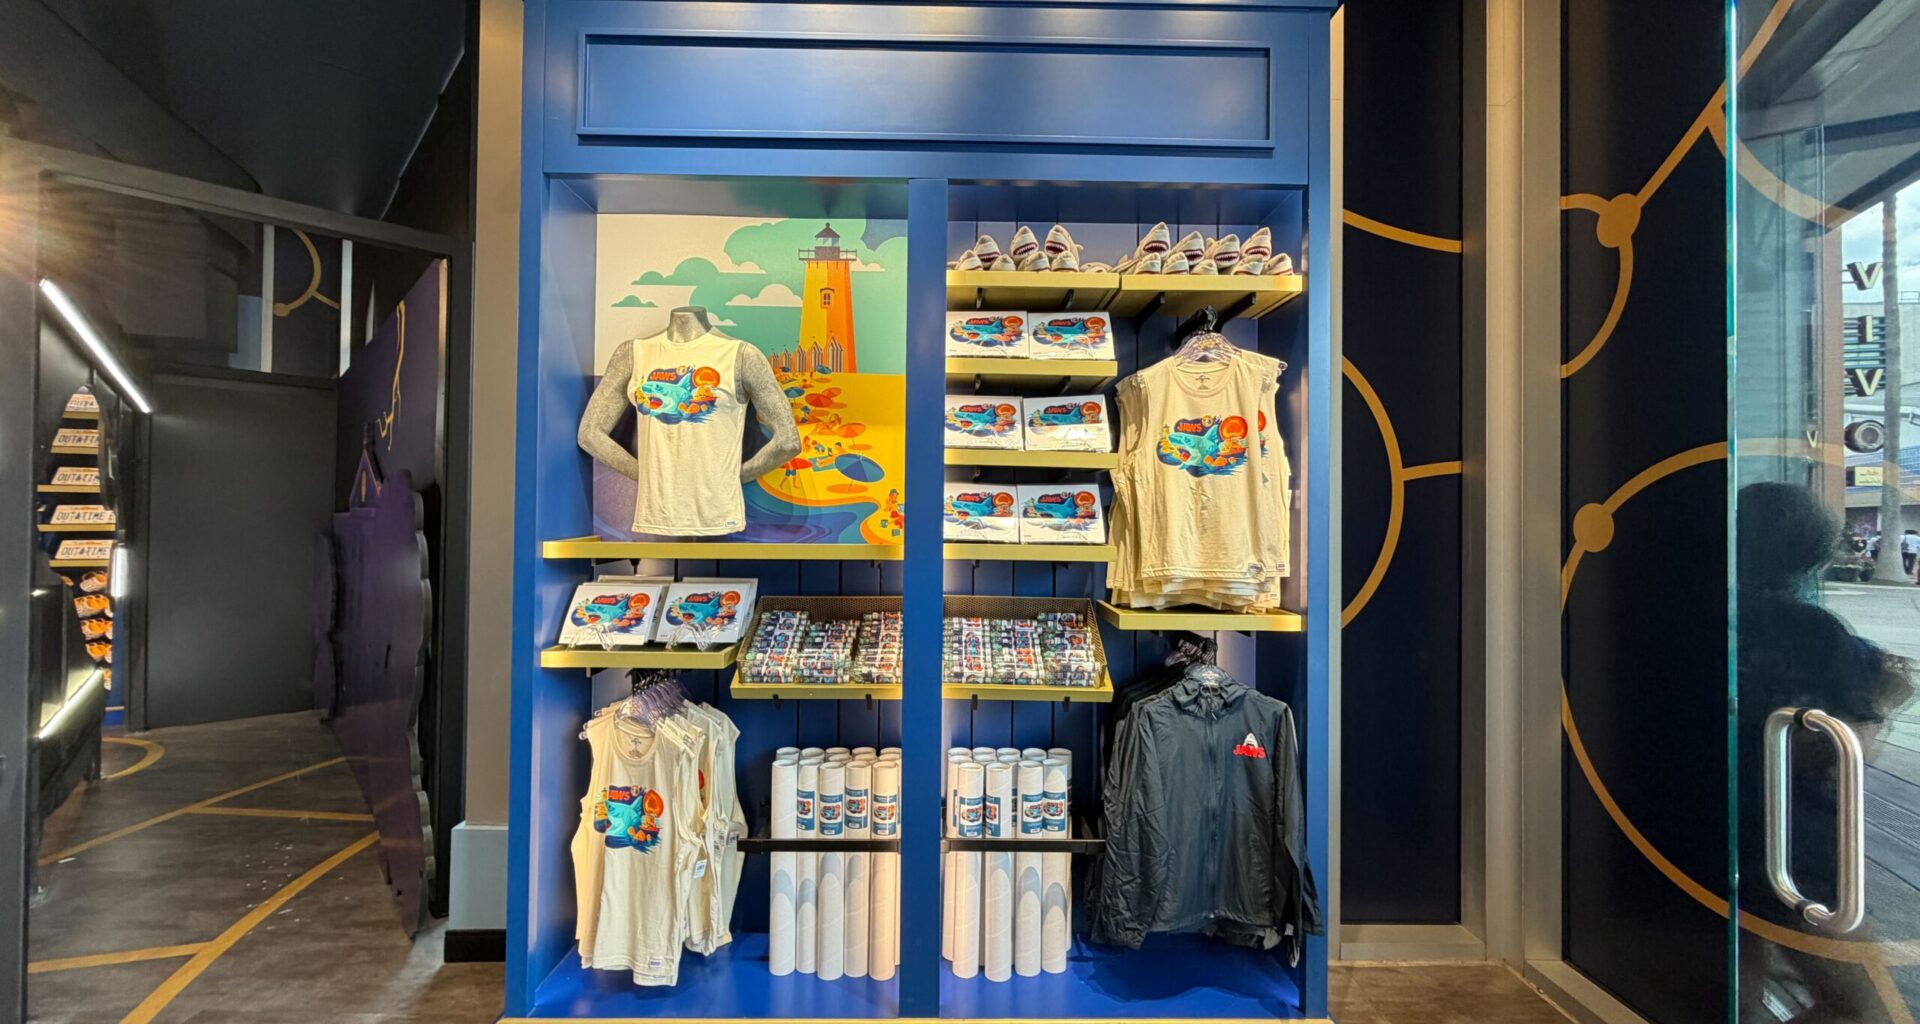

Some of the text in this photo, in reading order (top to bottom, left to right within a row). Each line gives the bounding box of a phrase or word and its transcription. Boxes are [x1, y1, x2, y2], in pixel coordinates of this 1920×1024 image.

[649, 371, 677, 381] JAWS
[1177, 423, 1202, 433] JAWS
[58, 434, 99, 444] OUTATI
[56, 511, 105, 521] OUTATIME
[1232, 744, 1266, 759] JAWS
